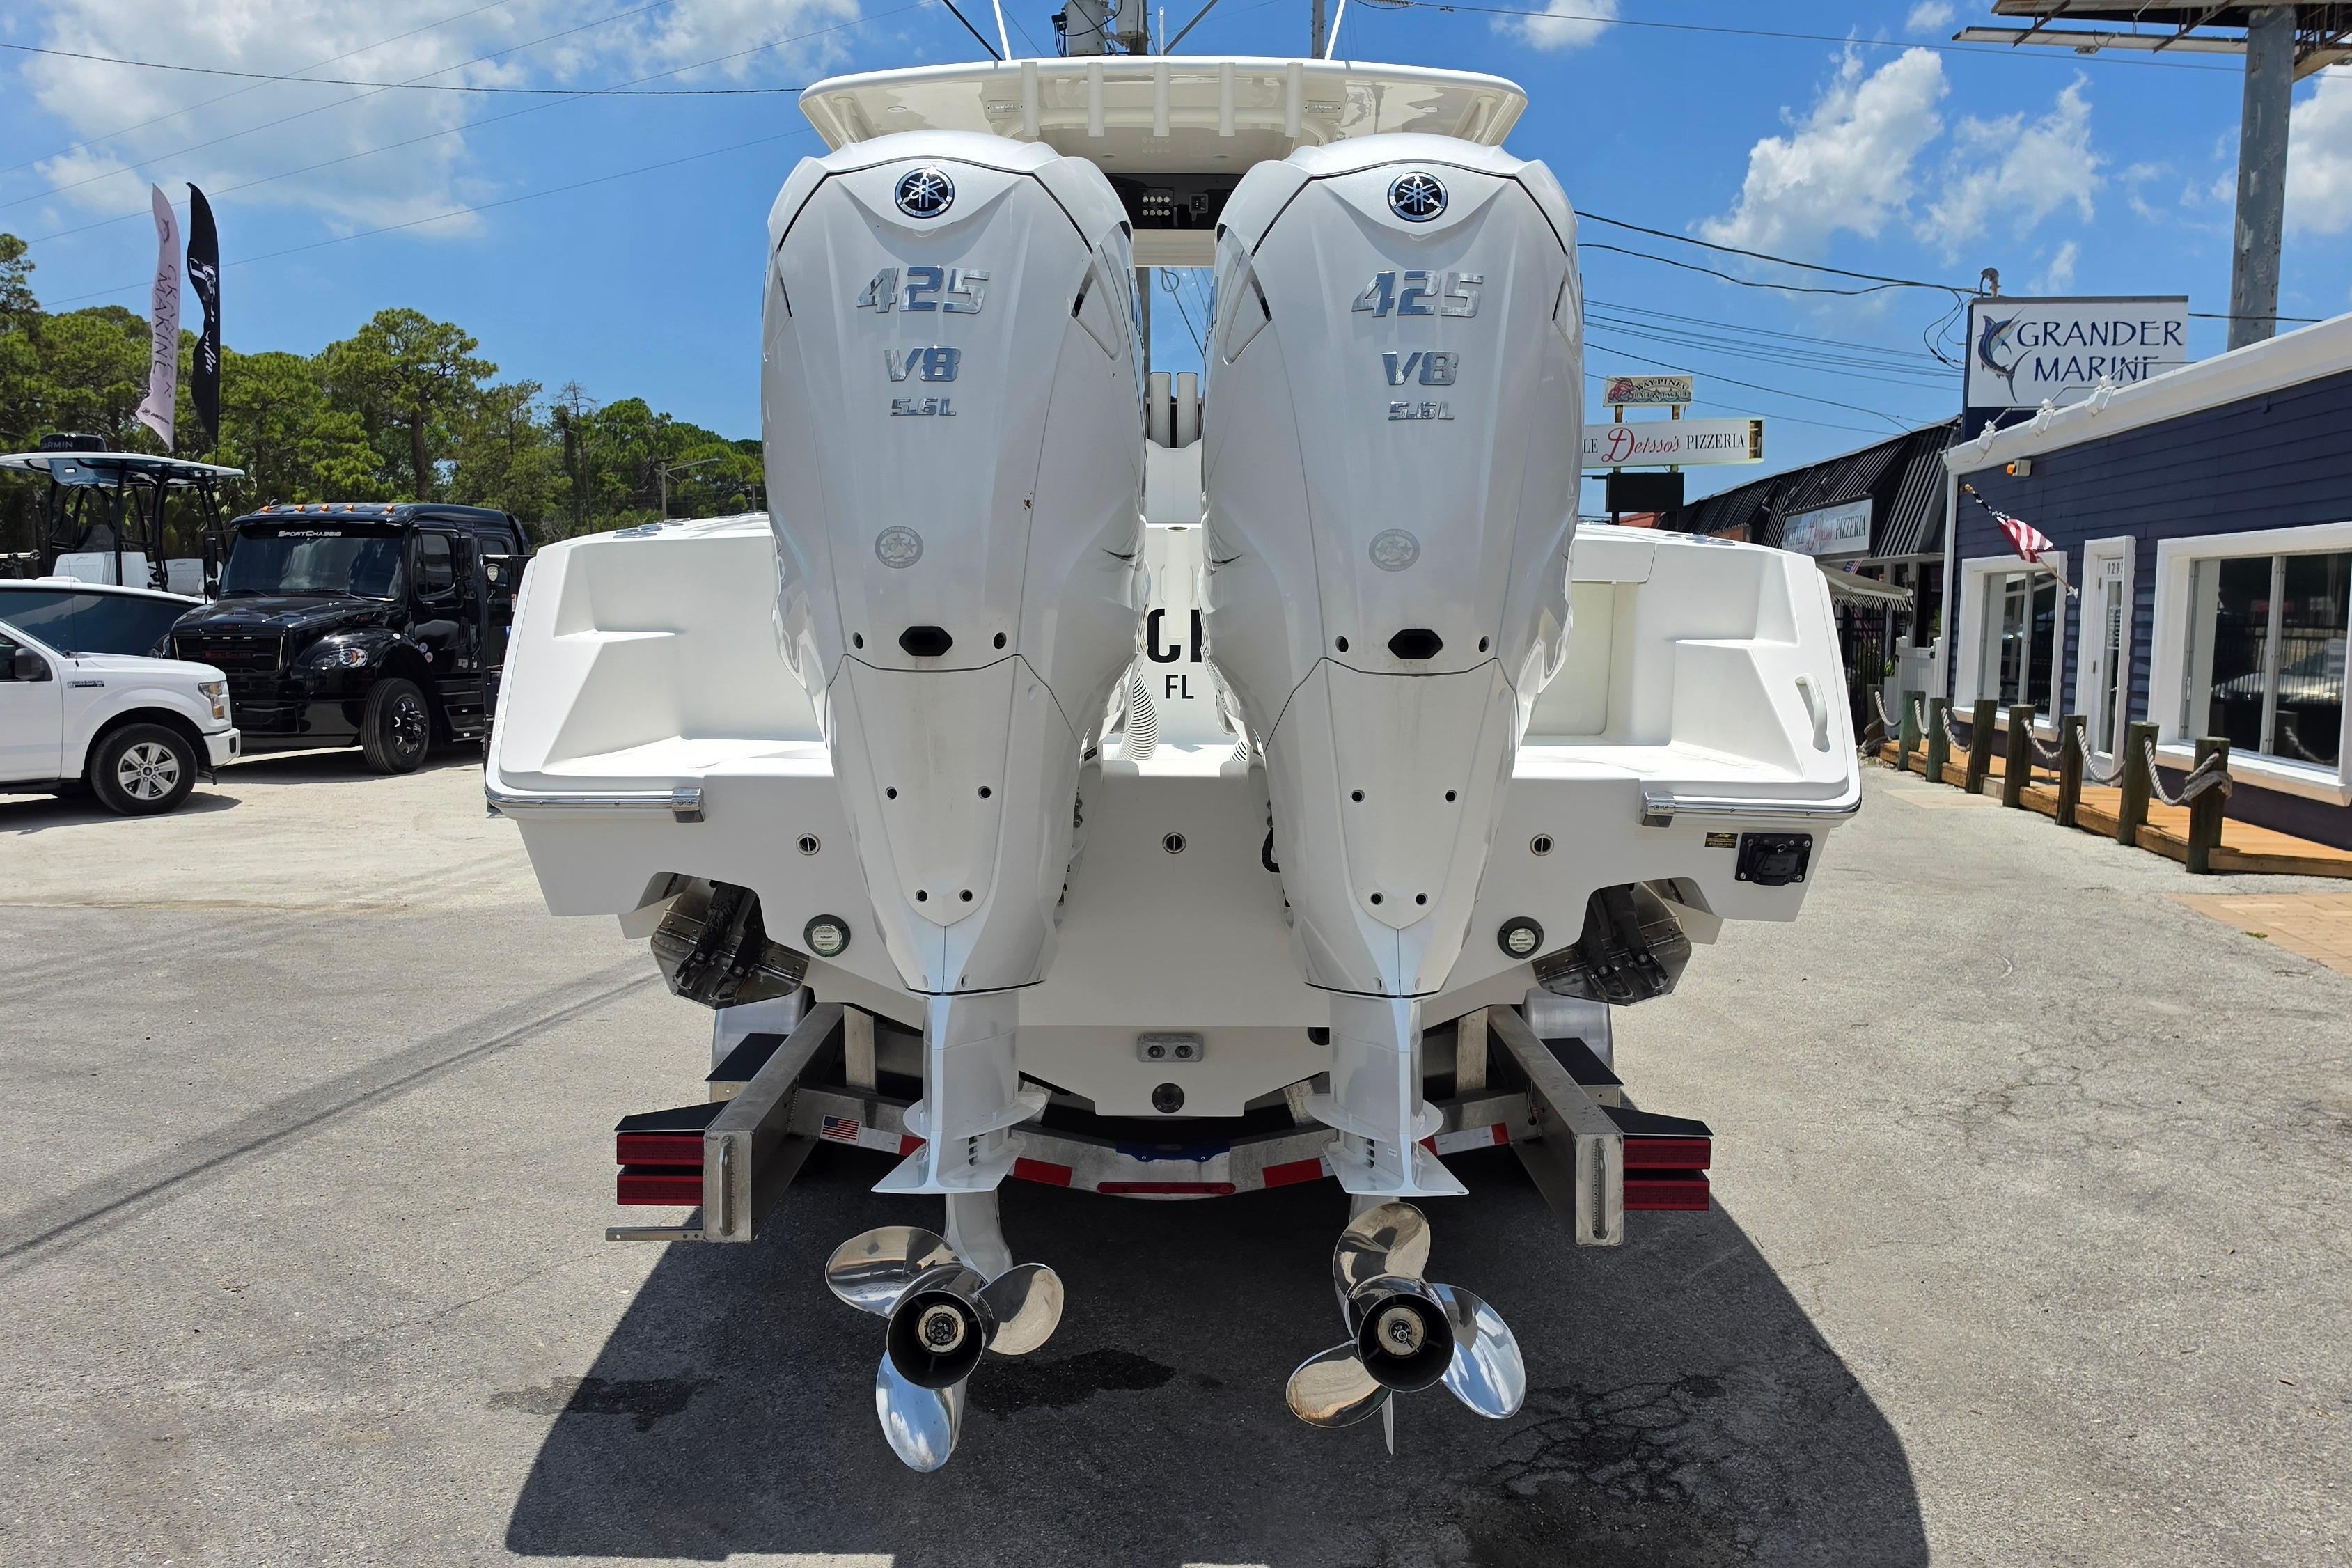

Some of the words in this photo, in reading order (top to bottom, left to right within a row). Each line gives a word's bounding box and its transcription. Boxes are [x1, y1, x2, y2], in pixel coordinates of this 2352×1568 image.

[856, 266, 990, 314] 425
[1351, 270, 1484, 318] 425
[2017, 321, 2184, 347] GRANDER
[884, 346, 961, 382] V8
[1381, 351, 1459, 386] V8
[2034, 356, 2159, 382] MARINE
[1636, 379, 1654, 390] BAY
[1657, 379, 1688, 389] PINES
[890, 397, 957, 416] 5.6L
[1388, 400, 1455, 421] 5.6L
[1686, 432, 1746, 450] PIZZERIA
[1835, 514, 1866, 540] PIZZERIA
[1166, 675, 1194, 699] FL
